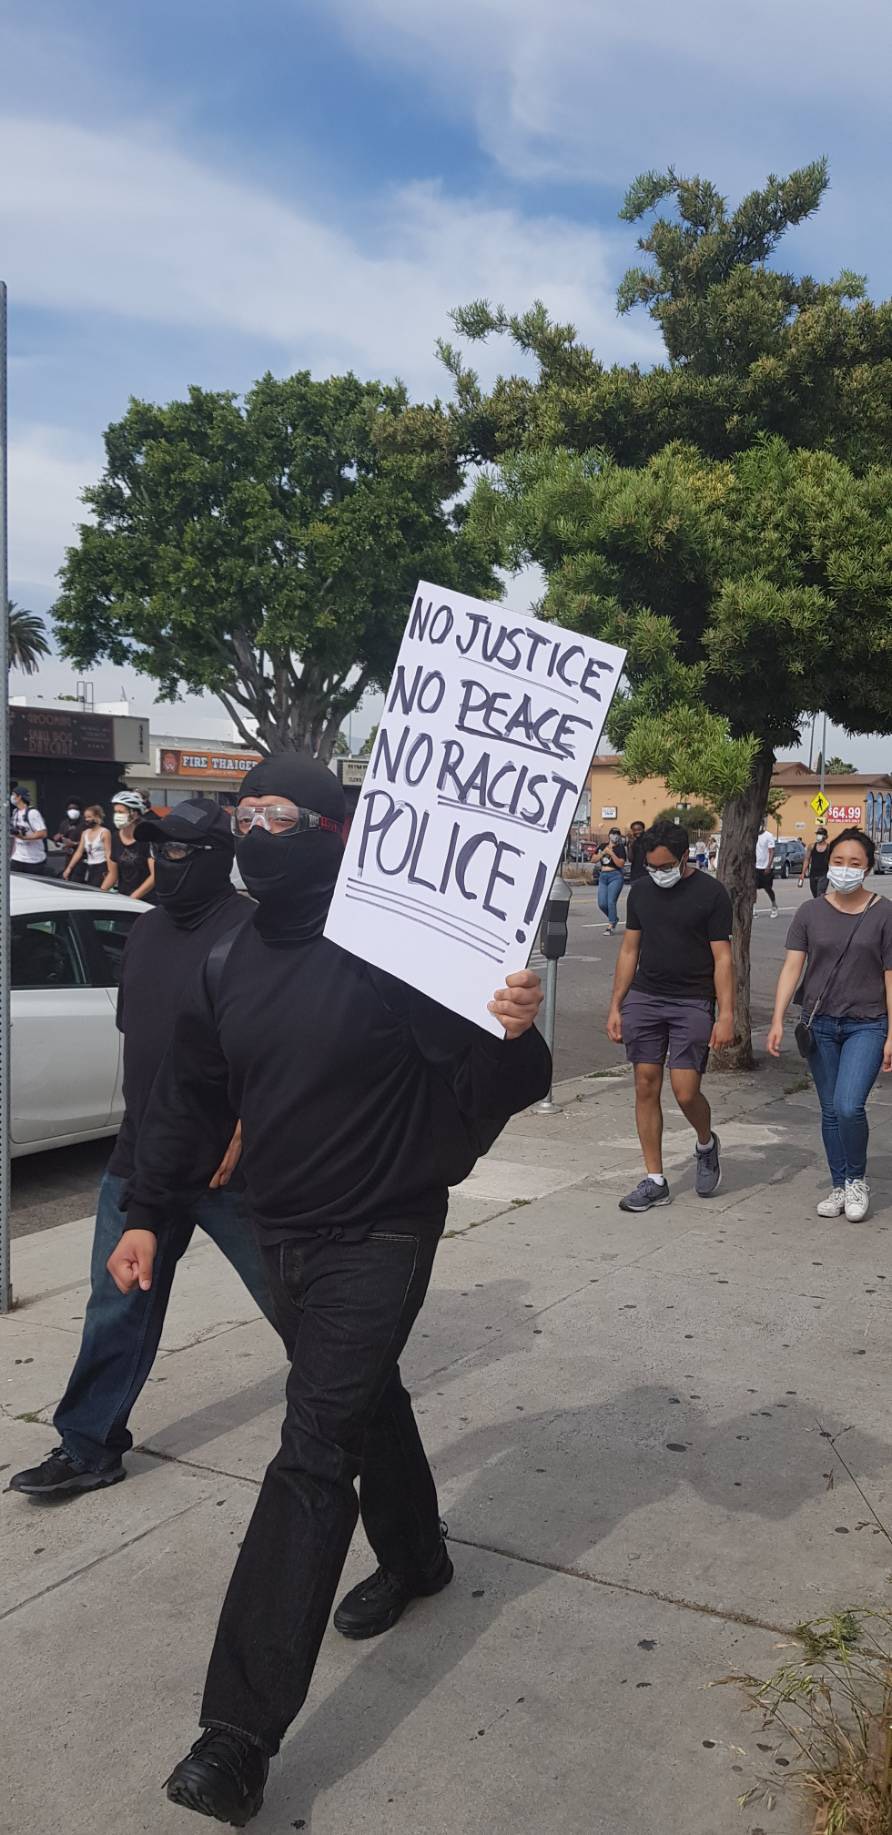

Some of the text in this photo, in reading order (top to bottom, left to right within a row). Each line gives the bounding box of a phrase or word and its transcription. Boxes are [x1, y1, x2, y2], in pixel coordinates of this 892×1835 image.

[407, 597, 614, 702] NO JUSTICE
[388, 665, 592, 758] NO PEACE
[182, 756, 208, 768] FIRE
[373, 726, 578, 832] NO RACIST
[828, 807, 860, 819] $64.99
[357, 790, 548, 944] POLICE!
